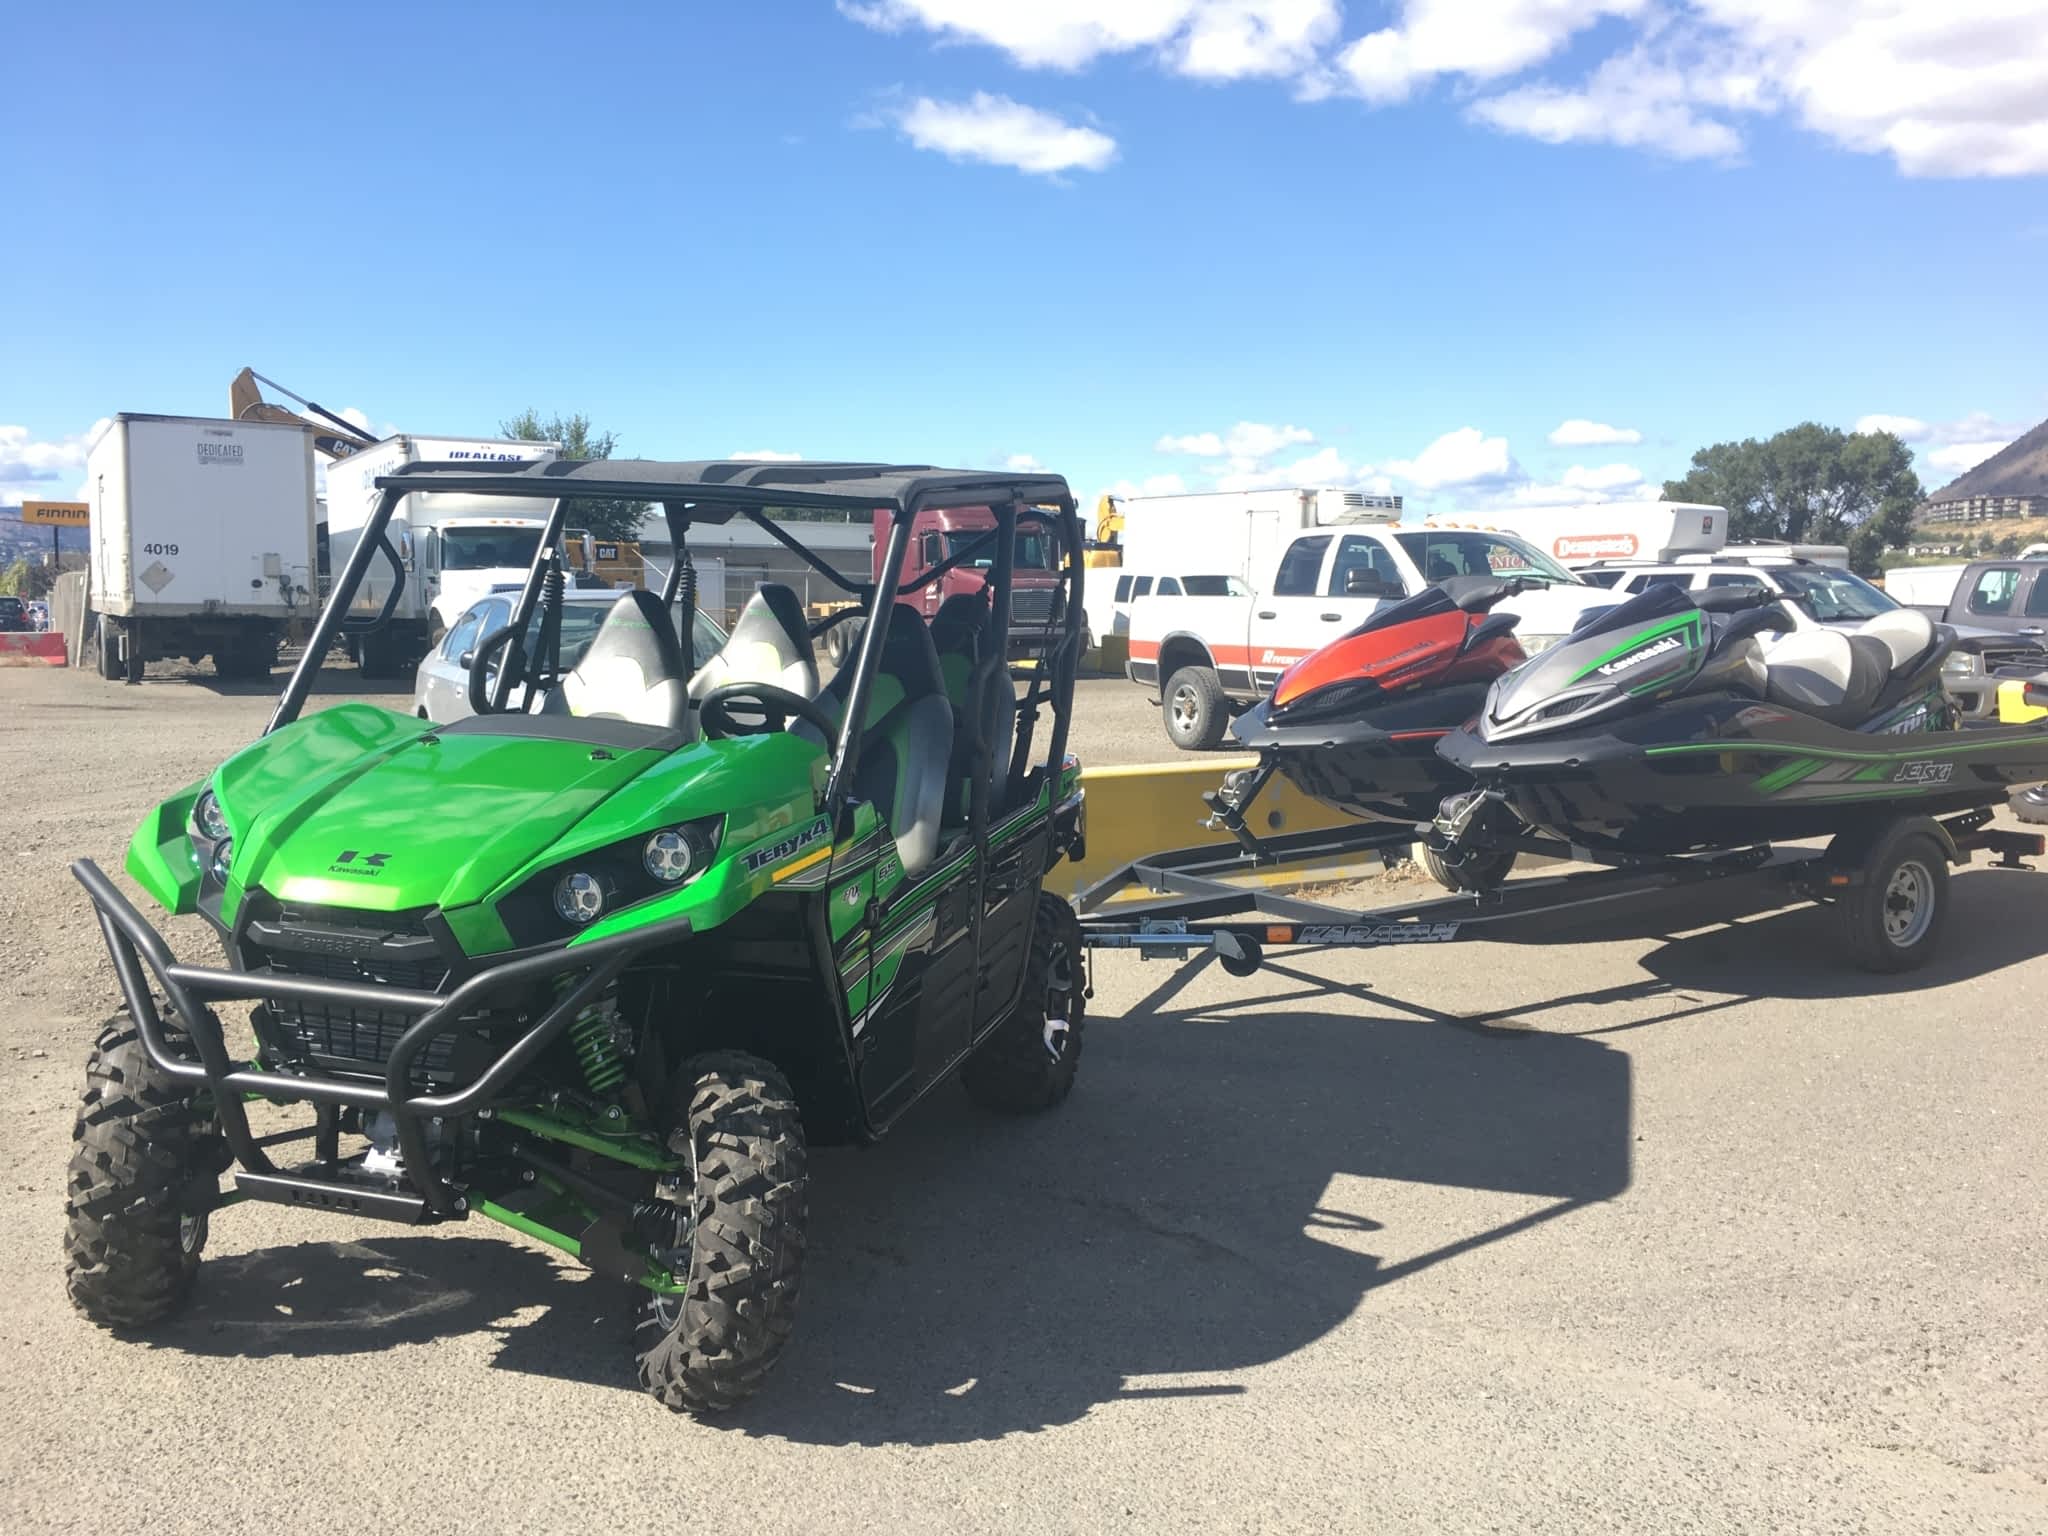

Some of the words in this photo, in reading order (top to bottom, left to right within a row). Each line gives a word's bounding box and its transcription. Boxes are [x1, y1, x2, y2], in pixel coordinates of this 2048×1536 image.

[197, 443, 243, 457] DEDICATED
[449, 450, 523, 462] IDEALEASE
[37, 508, 89, 519] FINNIN
[143, 543, 179, 556] 4019
[599, 548, 616, 558] CAT
[1598, 637, 1682, 675] Kawasaki
[327, 864, 381, 877] Kawasaki
[1296, 921, 1461, 944] KARAVAN
